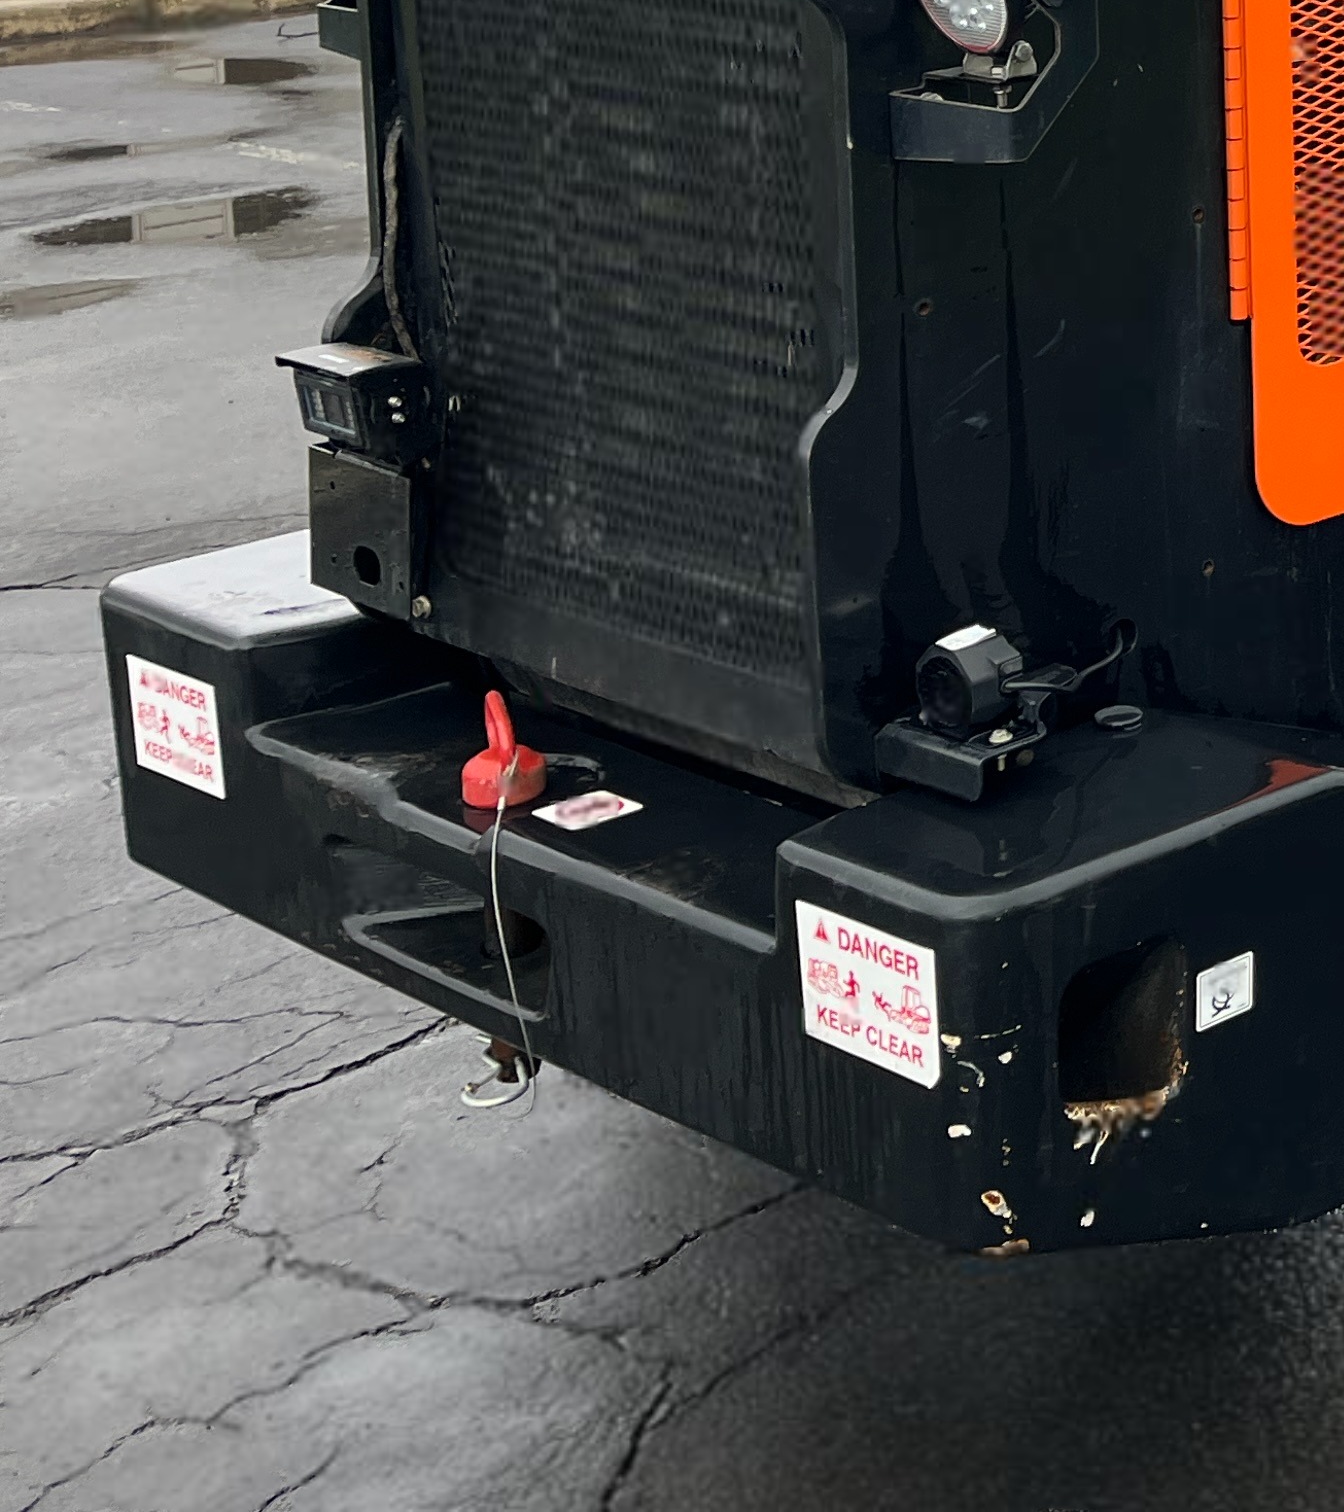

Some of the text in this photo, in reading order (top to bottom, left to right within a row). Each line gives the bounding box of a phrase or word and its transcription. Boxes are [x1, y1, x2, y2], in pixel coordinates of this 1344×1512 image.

[153, 675, 206, 711] ANGER
[144, 739, 173, 763] KEEP
[837, 926, 920, 981] DANGER
[866, 1025, 924, 1068] CLEAR
